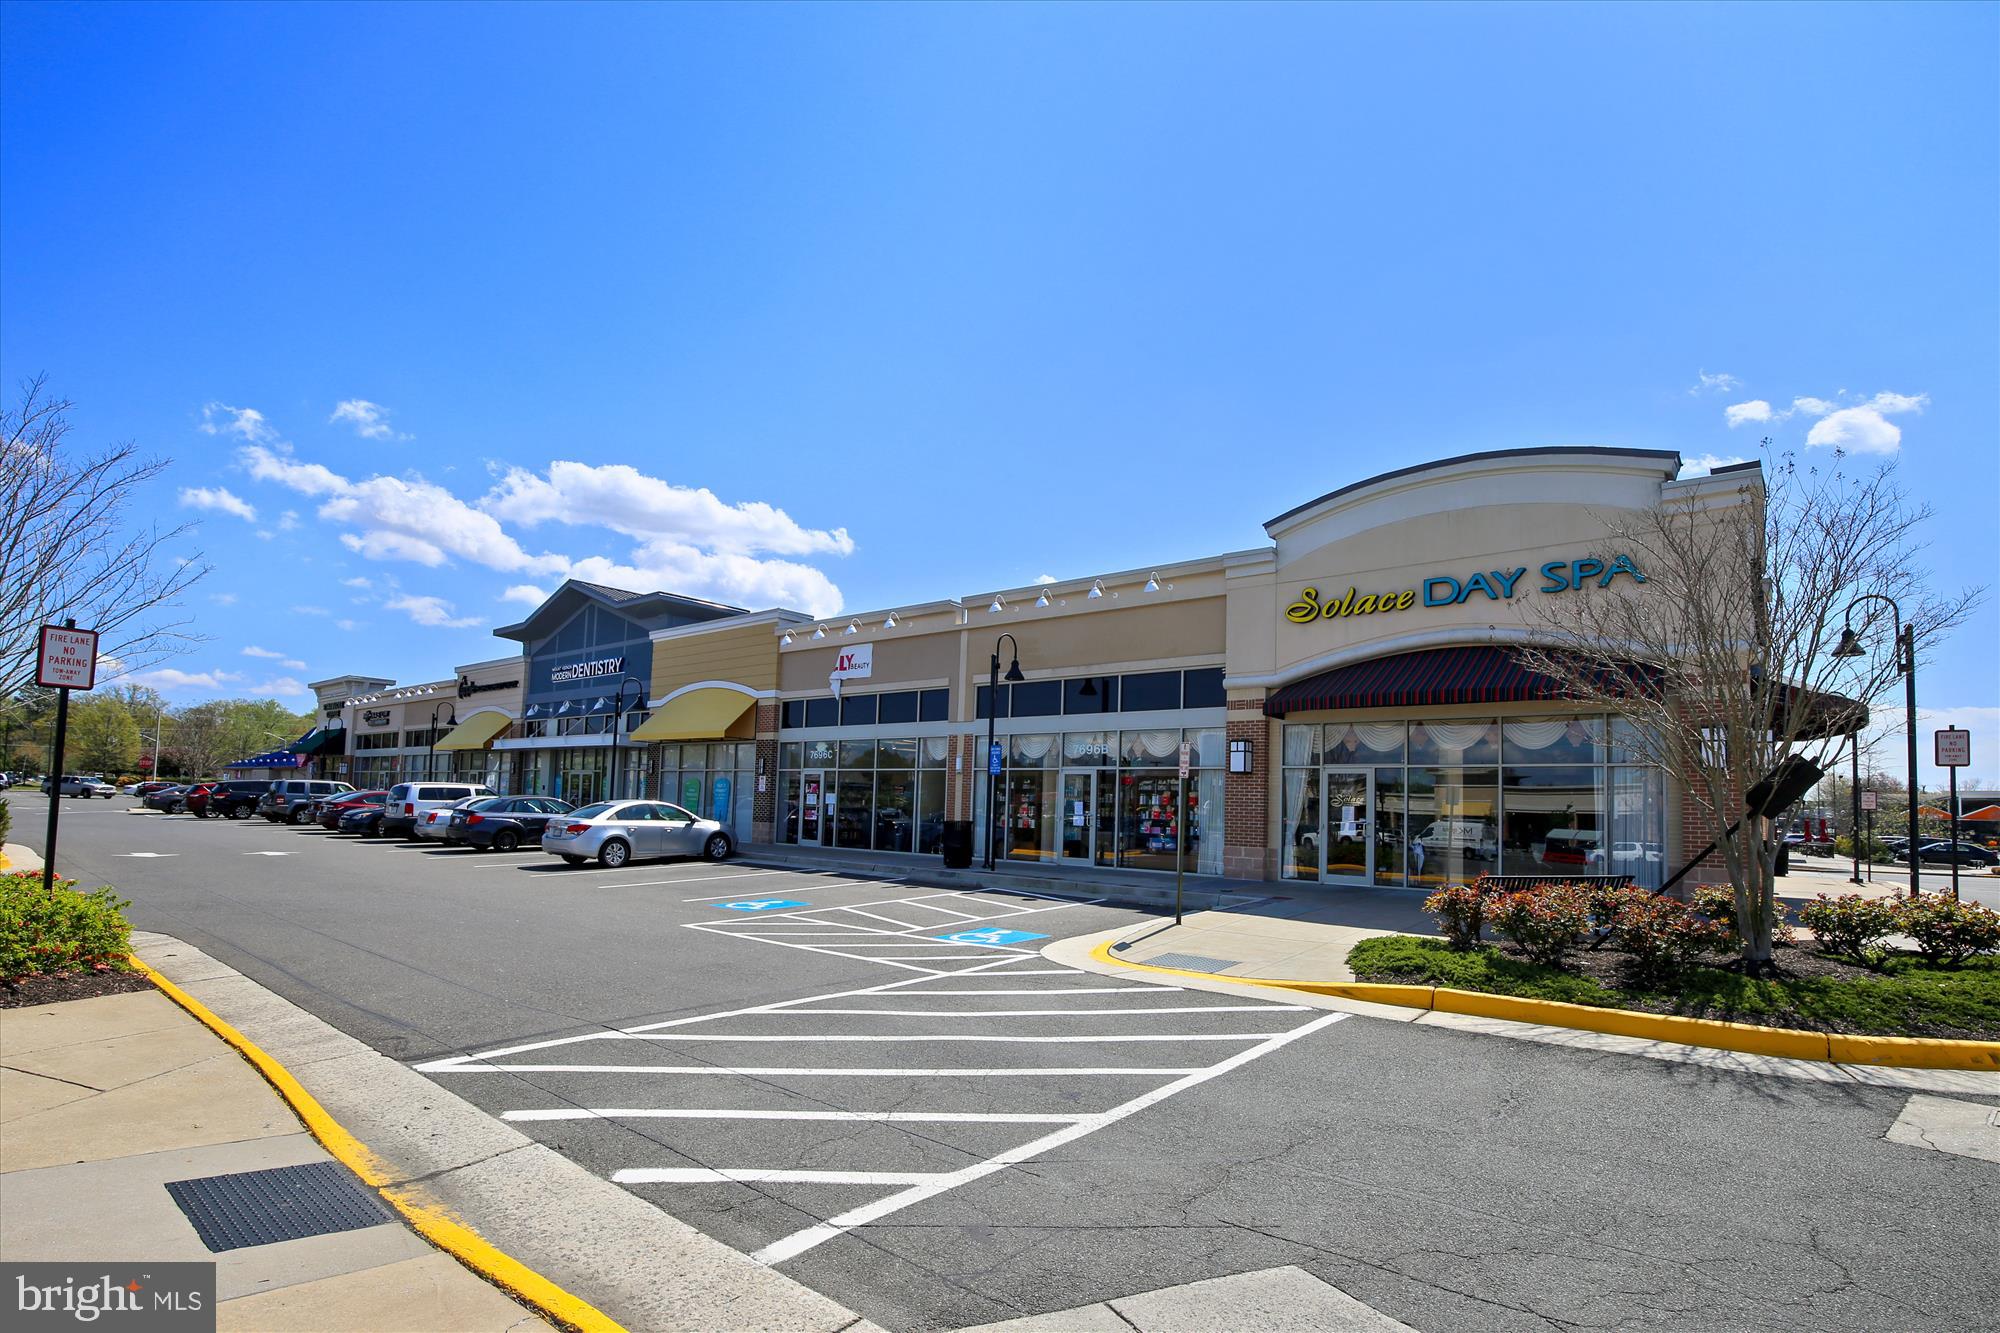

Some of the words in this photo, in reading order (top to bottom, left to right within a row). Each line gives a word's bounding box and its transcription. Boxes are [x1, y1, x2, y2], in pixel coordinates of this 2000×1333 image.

[1285, 586, 1415, 624] Solace
[1423, 567, 1527, 608] DAY
[1540, 554, 1647, 594] SPA
[50, 633, 68, 643] FIRE
[70, 636, 90, 646] LANE
[63, 646, 75, 656] NO
[48, 655, 88, 668] PARKING
[832, 653, 855, 672] LY
[850, 662, 870, 670] BEAUTY
[52, 667, 81, 676] TOW-AWAY
[551, 671, 573, 681] MODERN
[572, 657, 622, 679] DENTISTRY
[810, 750, 833, 759] 7696C
[1073, 743, 1109, 755] 7696B
